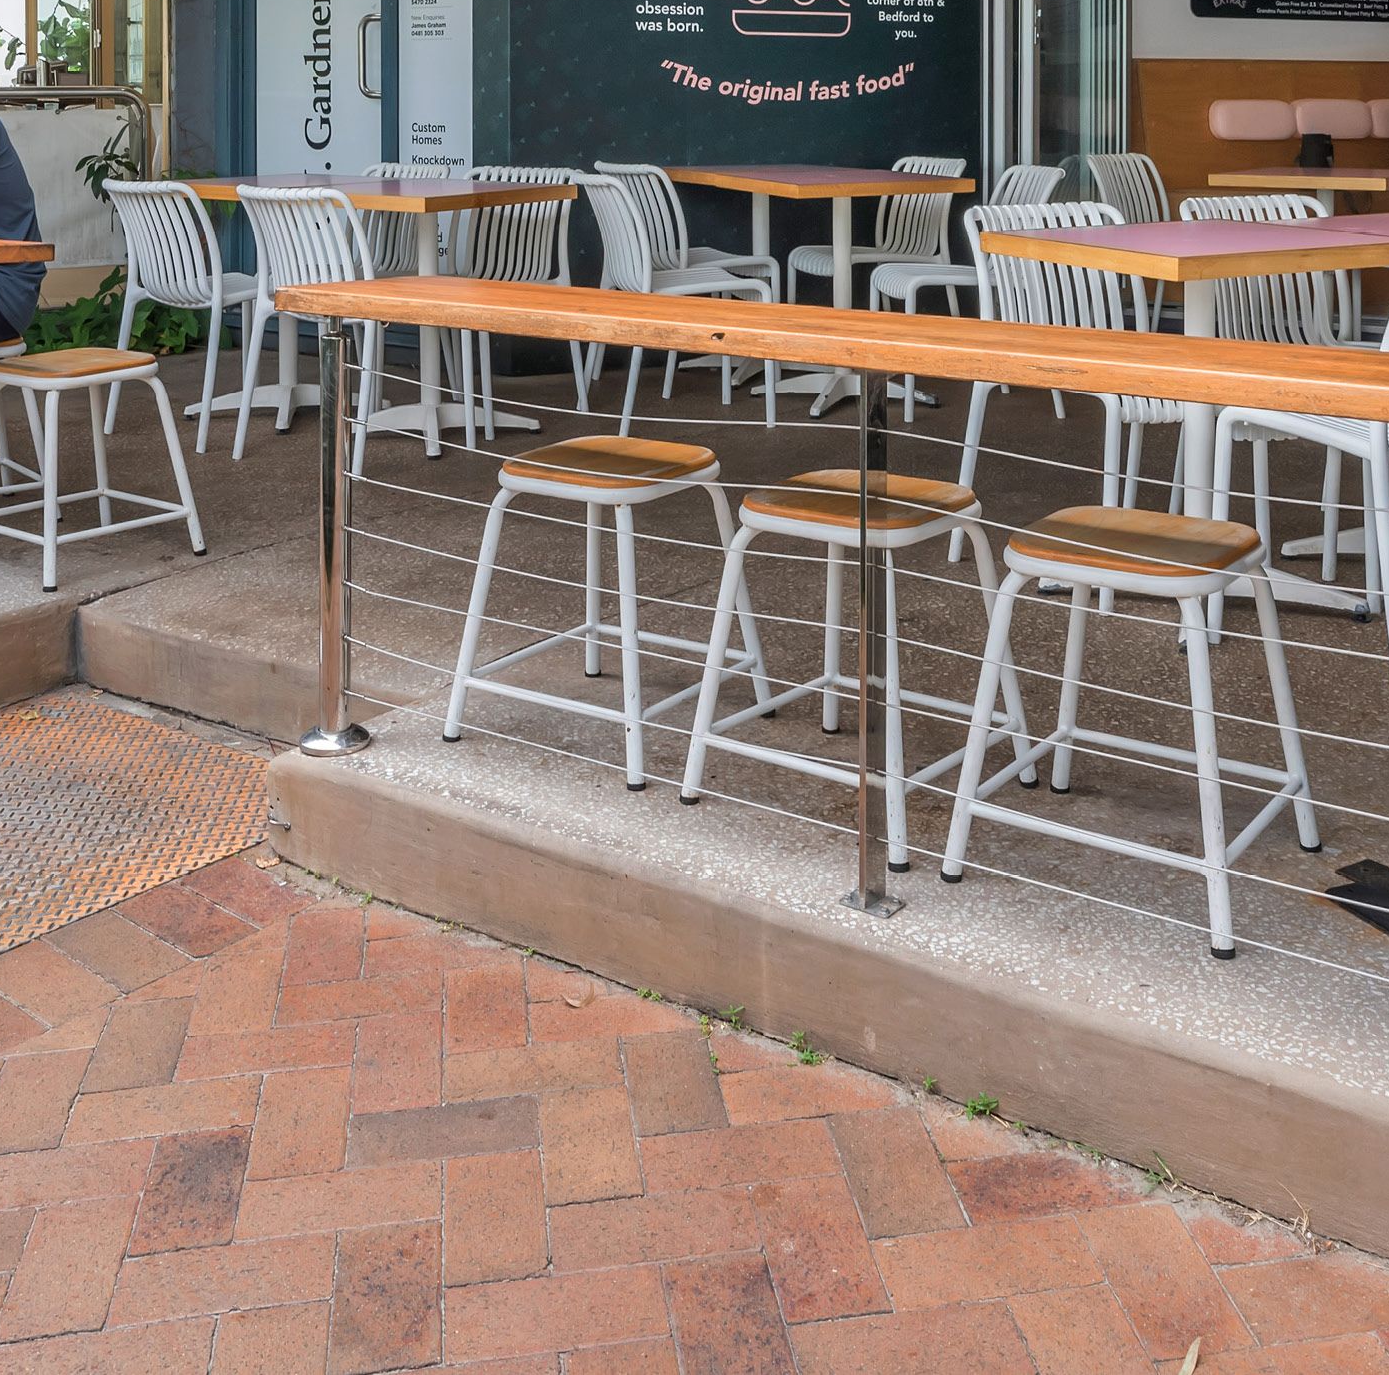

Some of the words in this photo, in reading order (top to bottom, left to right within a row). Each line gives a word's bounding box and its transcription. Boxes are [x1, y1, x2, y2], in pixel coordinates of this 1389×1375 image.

[636, 0, 704, 16] obsession
[878, 11, 920, 22] Bedford
[923, 13, 934, 23] to
[635, 21, 663, 32] was
[667, 18, 704, 32] born.
[895, 30, 917, 41] you.
[718, 79, 803, 106] original
[809, 80, 850, 101] fast
[412, 123, 446, 133] Custom
[412, 135, 442, 145] Homes
[412, 155, 464, 166] Knockdown
